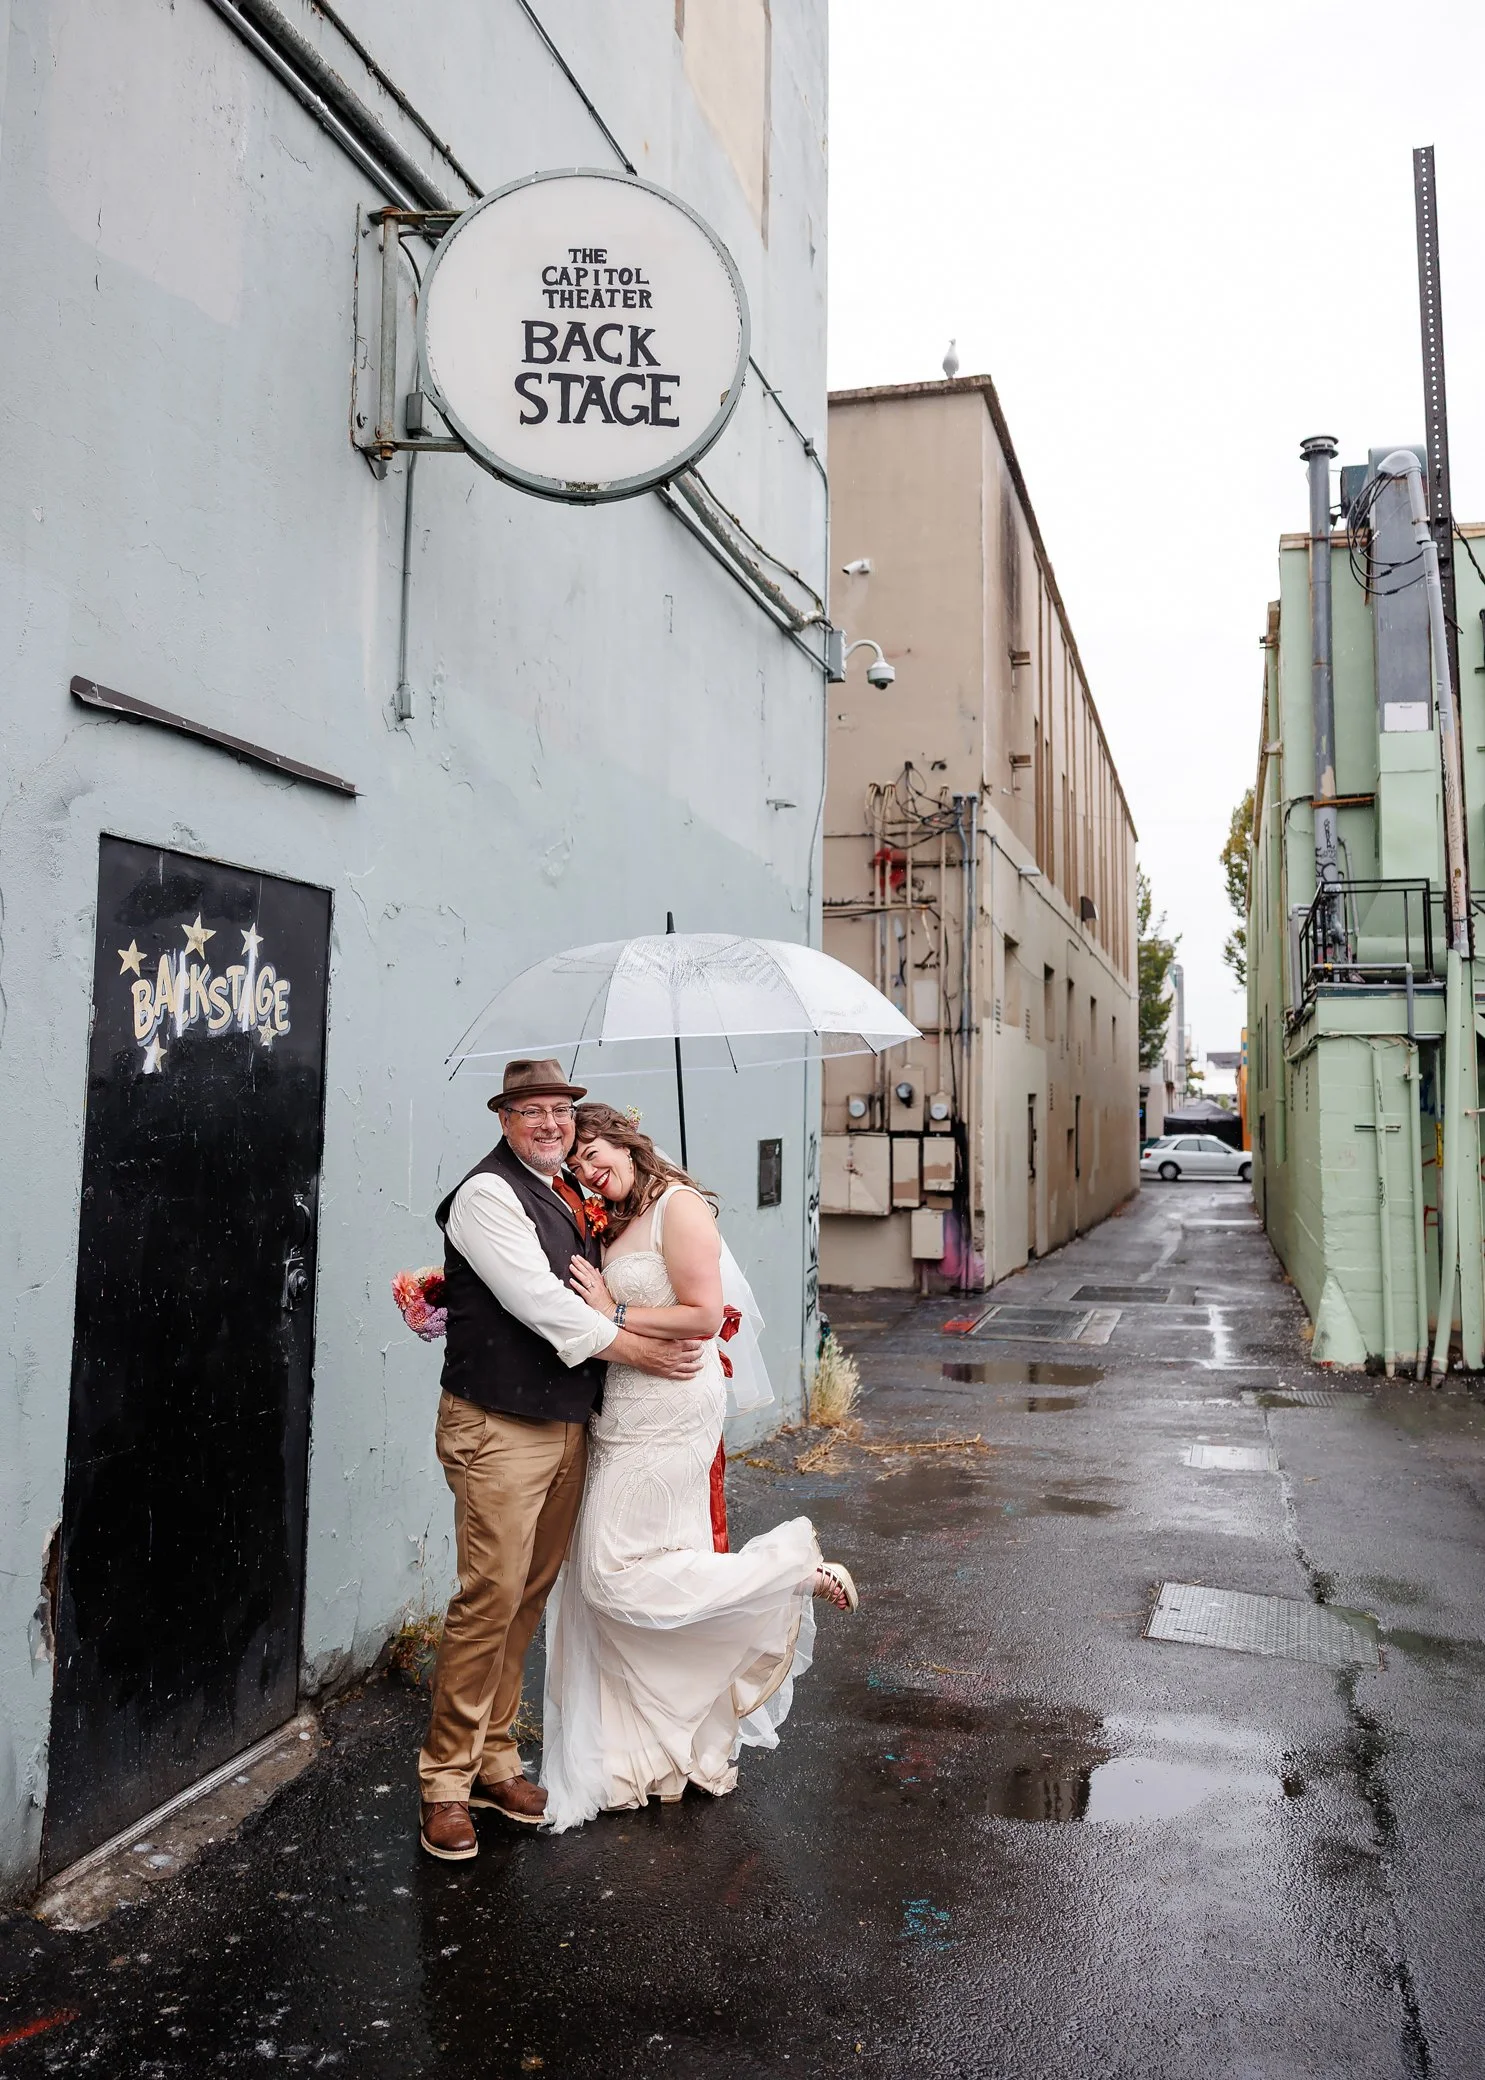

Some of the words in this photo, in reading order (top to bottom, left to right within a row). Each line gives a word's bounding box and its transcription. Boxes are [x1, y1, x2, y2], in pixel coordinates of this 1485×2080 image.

[568, 248, 608, 265] THE
[541, 266, 650, 287] CAPITOL
[542, 288, 653, 309] THEATER
[520, 320, 662, 367] BACK
[514, 372, 681, 428] STAGE
[131, 953, 291, 1045] BACKSTAGE
